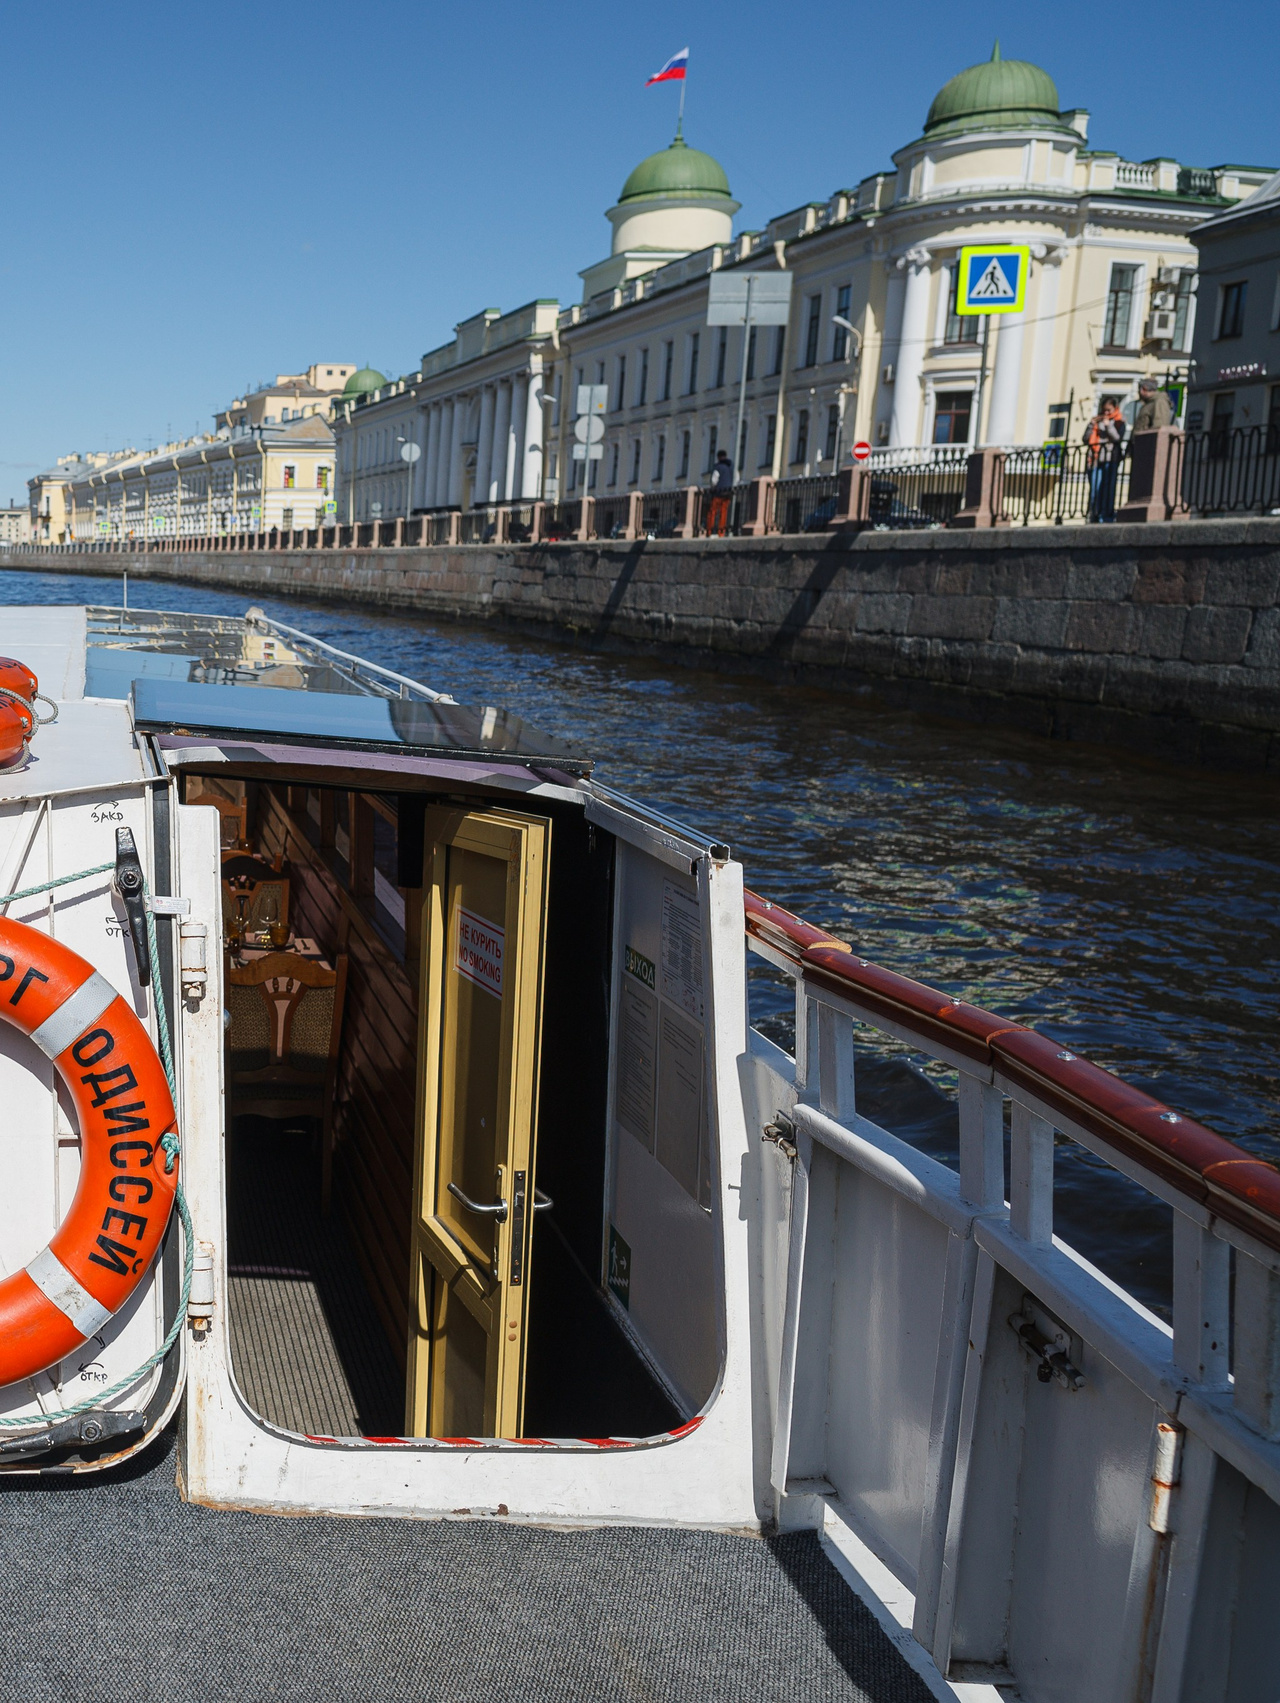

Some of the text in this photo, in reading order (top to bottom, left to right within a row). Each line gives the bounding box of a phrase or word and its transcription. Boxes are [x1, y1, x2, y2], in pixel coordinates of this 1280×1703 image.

[105, 927, 131, 938] ОТК
[459, 922, 502, 959] НЕ КУРИТЬ
[459, 943, 501, 983] NO SMOKING
[625, 950, 655, 988] ВЫХОД
[71, 1028, 154, 1276] ОДИССЕЙ
[80, 1372, 108, 1384] ОТКР
